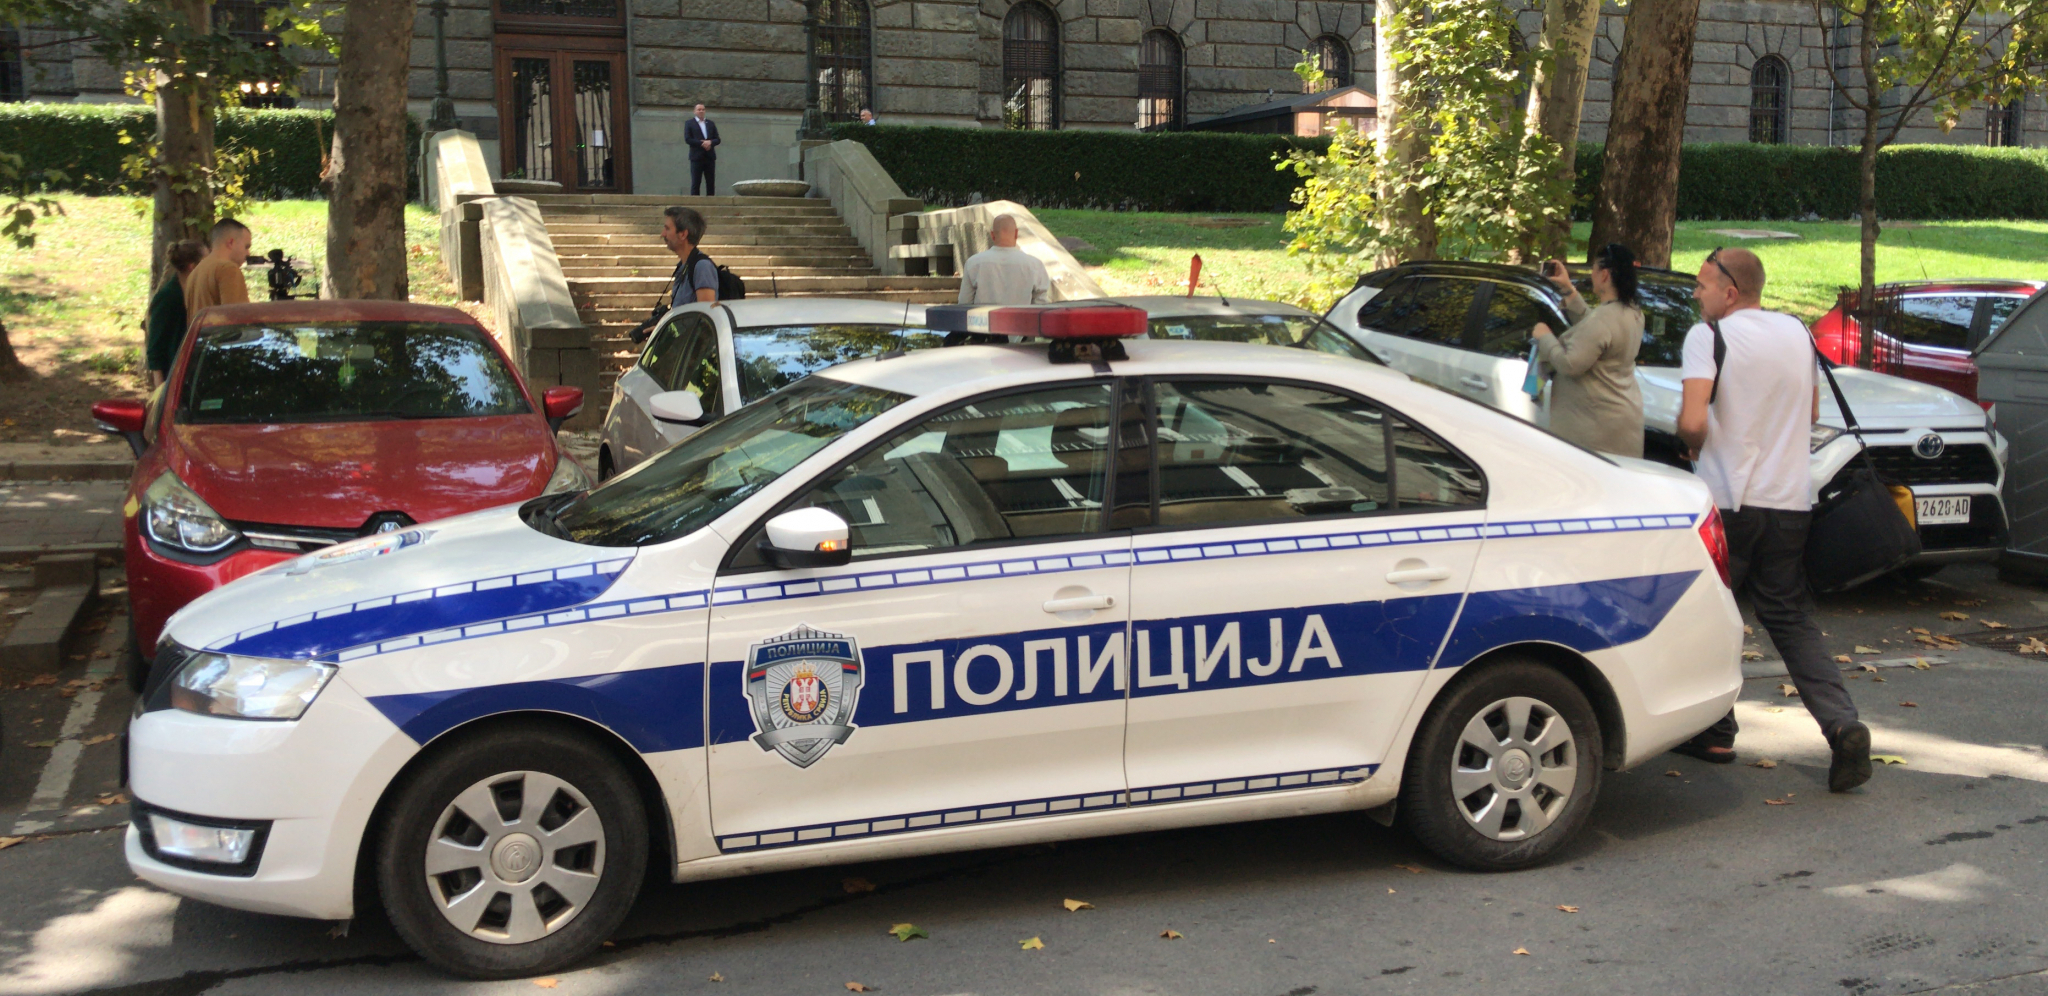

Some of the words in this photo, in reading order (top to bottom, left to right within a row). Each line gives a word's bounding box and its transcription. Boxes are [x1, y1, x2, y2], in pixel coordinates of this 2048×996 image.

[767, 643, 840, 659] ПОЛИЦИЈА
[892, 614, 1343, 714] ПОЛИЦИЈА
[783, 693, 812, 721] РЕПУБЛИКА
[813, 688, 827, 716] СРБИЈА
